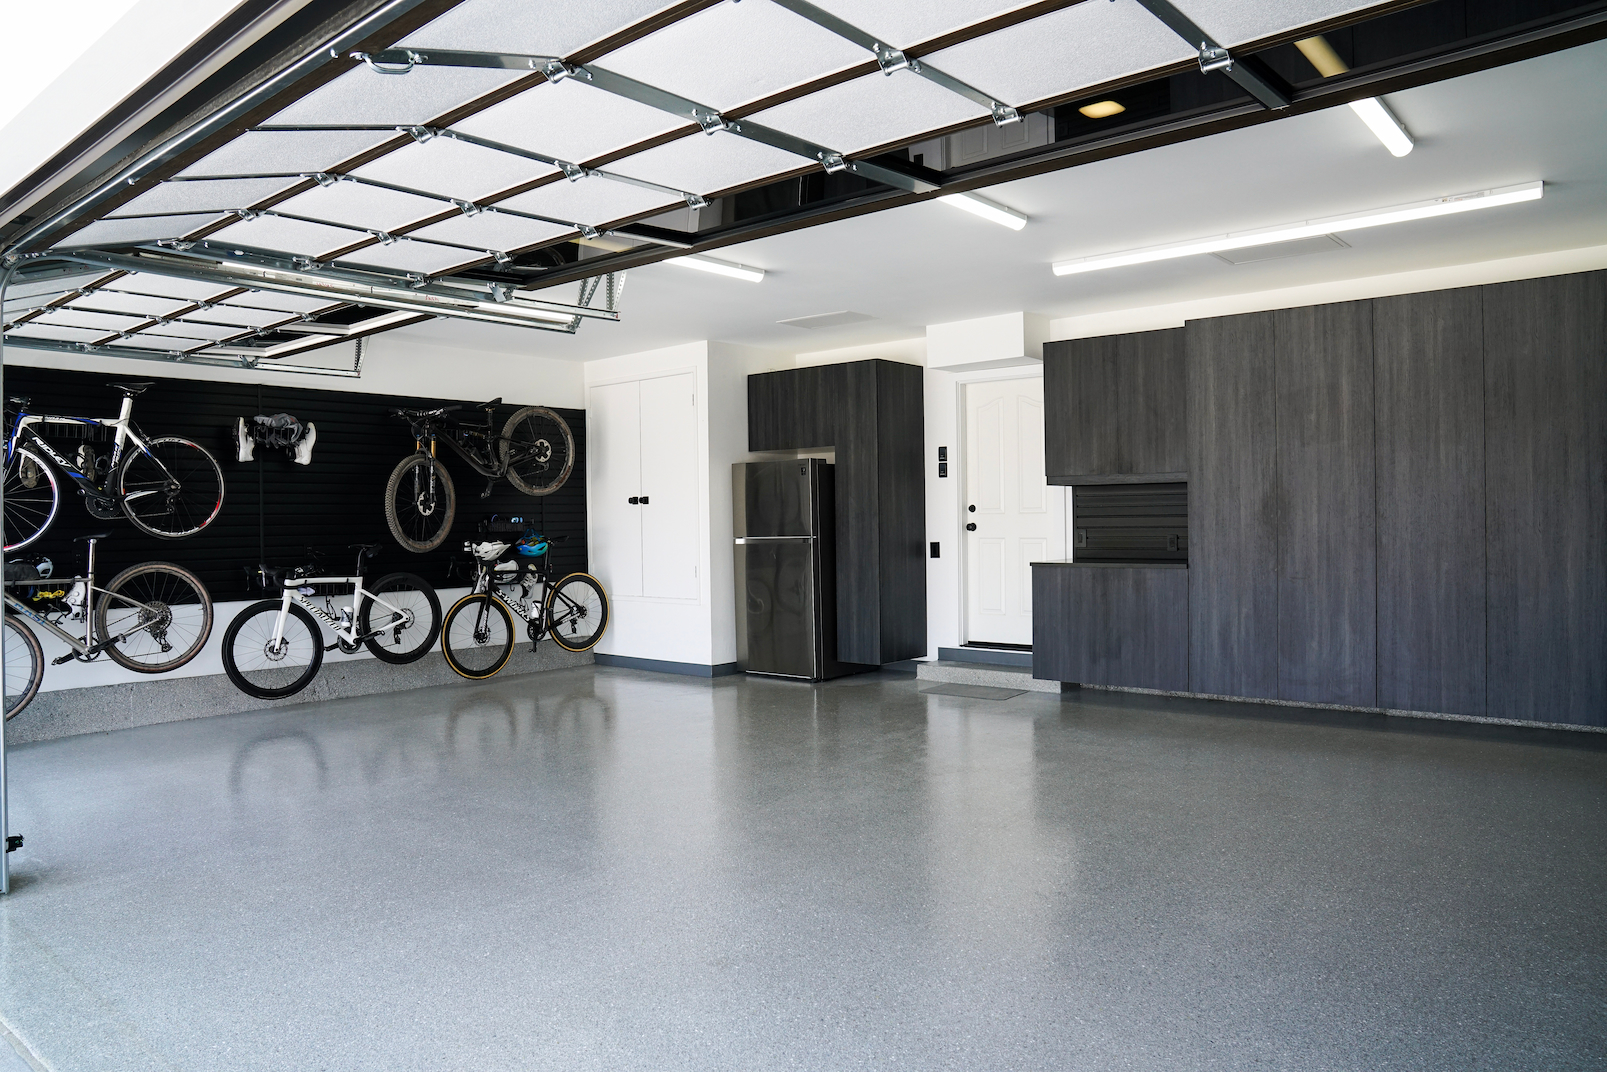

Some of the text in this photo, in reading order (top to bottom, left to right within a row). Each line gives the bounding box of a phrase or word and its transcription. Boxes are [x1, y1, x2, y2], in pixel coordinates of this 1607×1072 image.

[31, 436, 71, 467] RIDLEY
[299, 596, 342, 631] SPECIALIZED
[495, 589, 531, 622] S-WORKS
